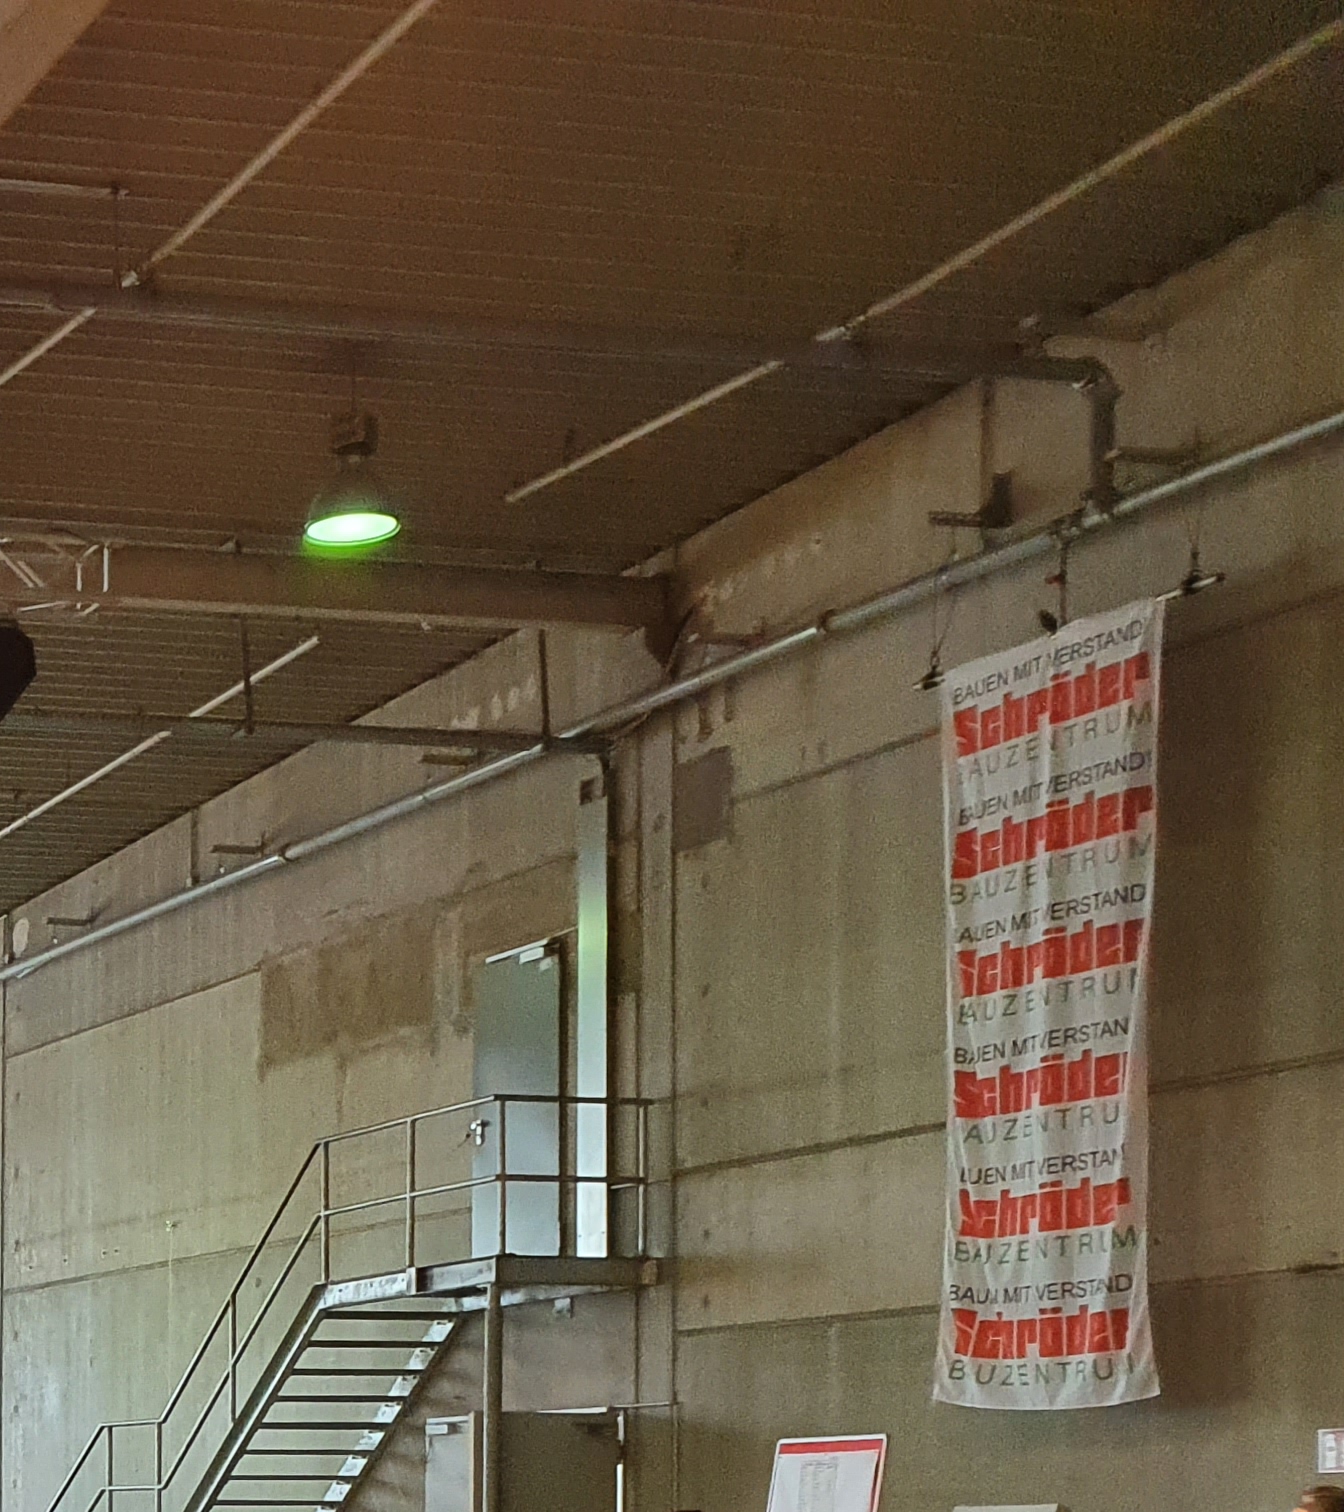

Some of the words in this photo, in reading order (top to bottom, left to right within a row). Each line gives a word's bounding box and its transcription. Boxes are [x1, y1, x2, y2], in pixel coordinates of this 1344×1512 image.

[953, 672, 1009, 706] BAUEN
[1013, 655, 1044, 682] MIT
[953, 651, 1151, 758] Schröder
[951, 785, 1153, 880] Schröder
[957, 917, 1146, 1000] Schröder
